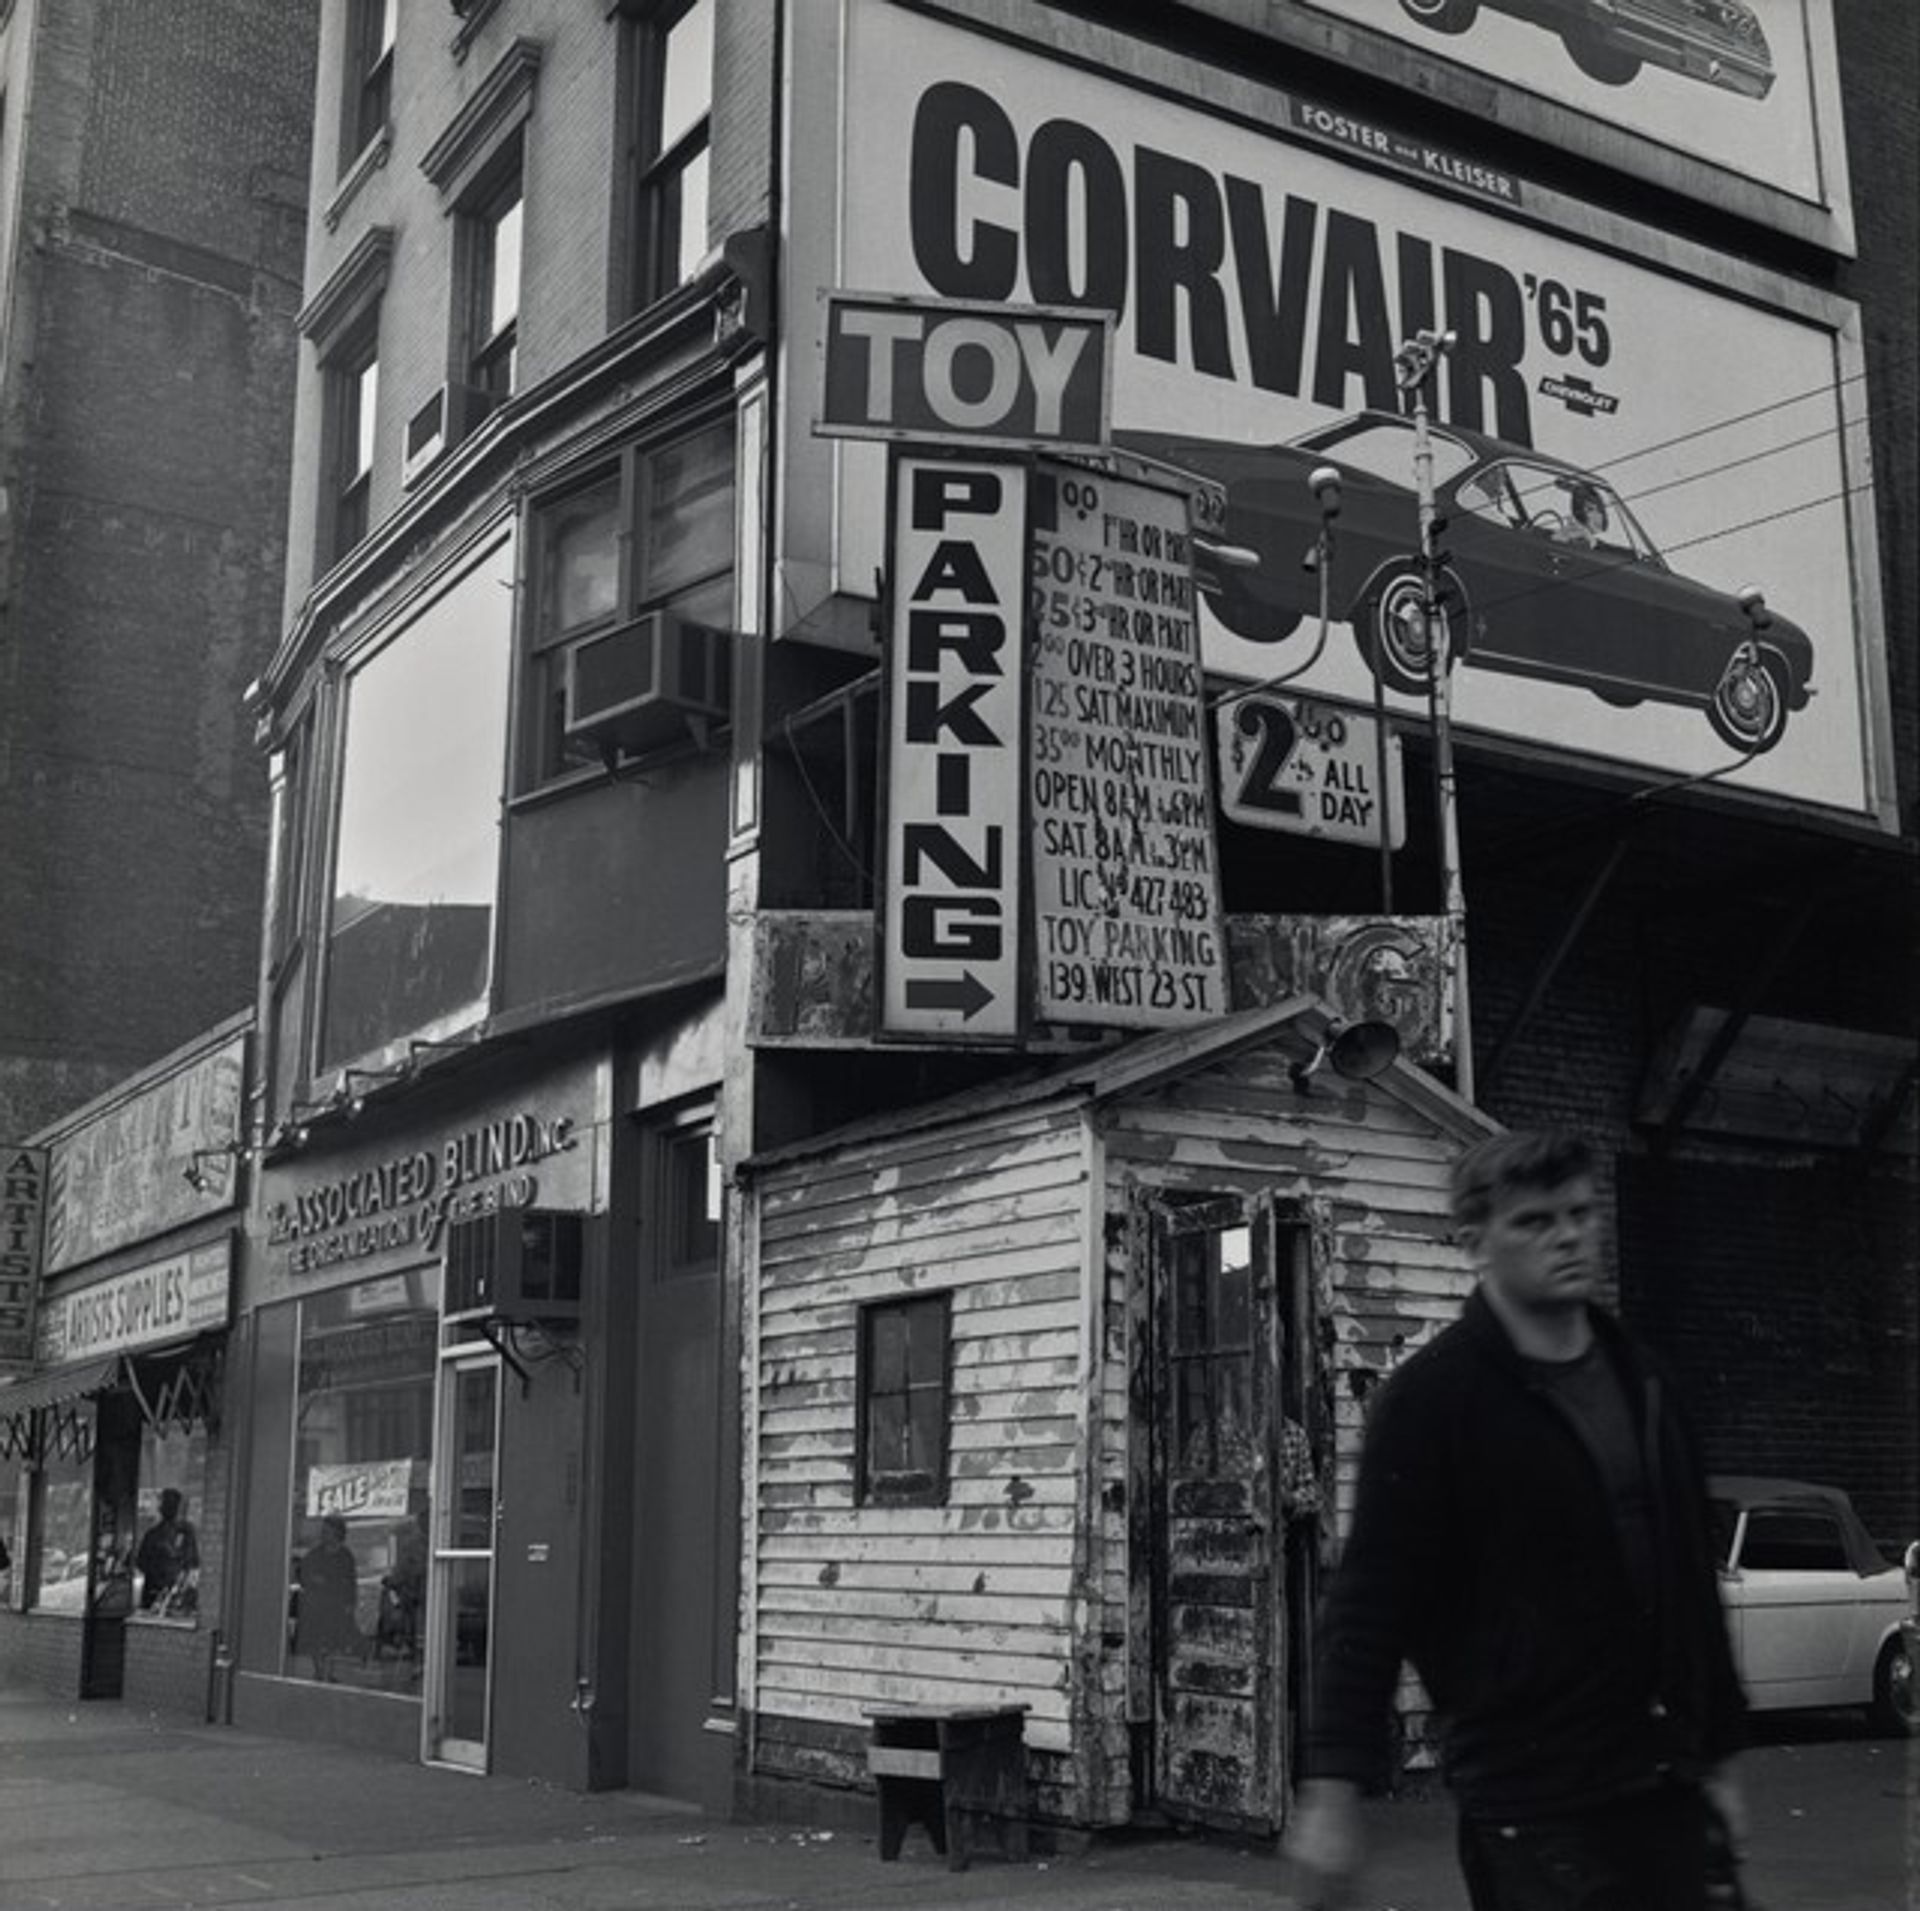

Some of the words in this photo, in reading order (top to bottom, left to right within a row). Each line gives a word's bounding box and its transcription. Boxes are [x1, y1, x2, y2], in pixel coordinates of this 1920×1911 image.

[1301, 104, 1388, 153] FOSTER
[1422, 150, 1513, 198] KLEISER
[910, 80, 1534, 450] CORVAIR
[840, 310, 1092, 436] TOY
[1133, 609, 1156, 647] OR
[1068, 638, 1116, 684] OVER
[1120, 651, 1136, 686] 3
[1141, 654, 1198, 697] HOURS
[902, 466, 1007, 962] PARKING
[1086, 733, 1200, 783] MONTHLY
[1324, 759, 1369, 795] ALL
[1035, 768, 1099, 815] OPEN
[1321, 791, 1373, 827] DAY
[1131, 876, 1165, 916] 427
[1170, 880, 1207, 921] 483
[1042, 915, 1095, 956] TOY
[1104, 920, 1216, 967] PARKING
[1092, 965, 1143, 1006] WEST
[1151, 968, 1177, 1009] 23
[289, 1152, 436, 1241] ASSOCIATED
[1, 1152, 38, 1332] ARTISTS
[320, 1475, 369, 1513] SALE
